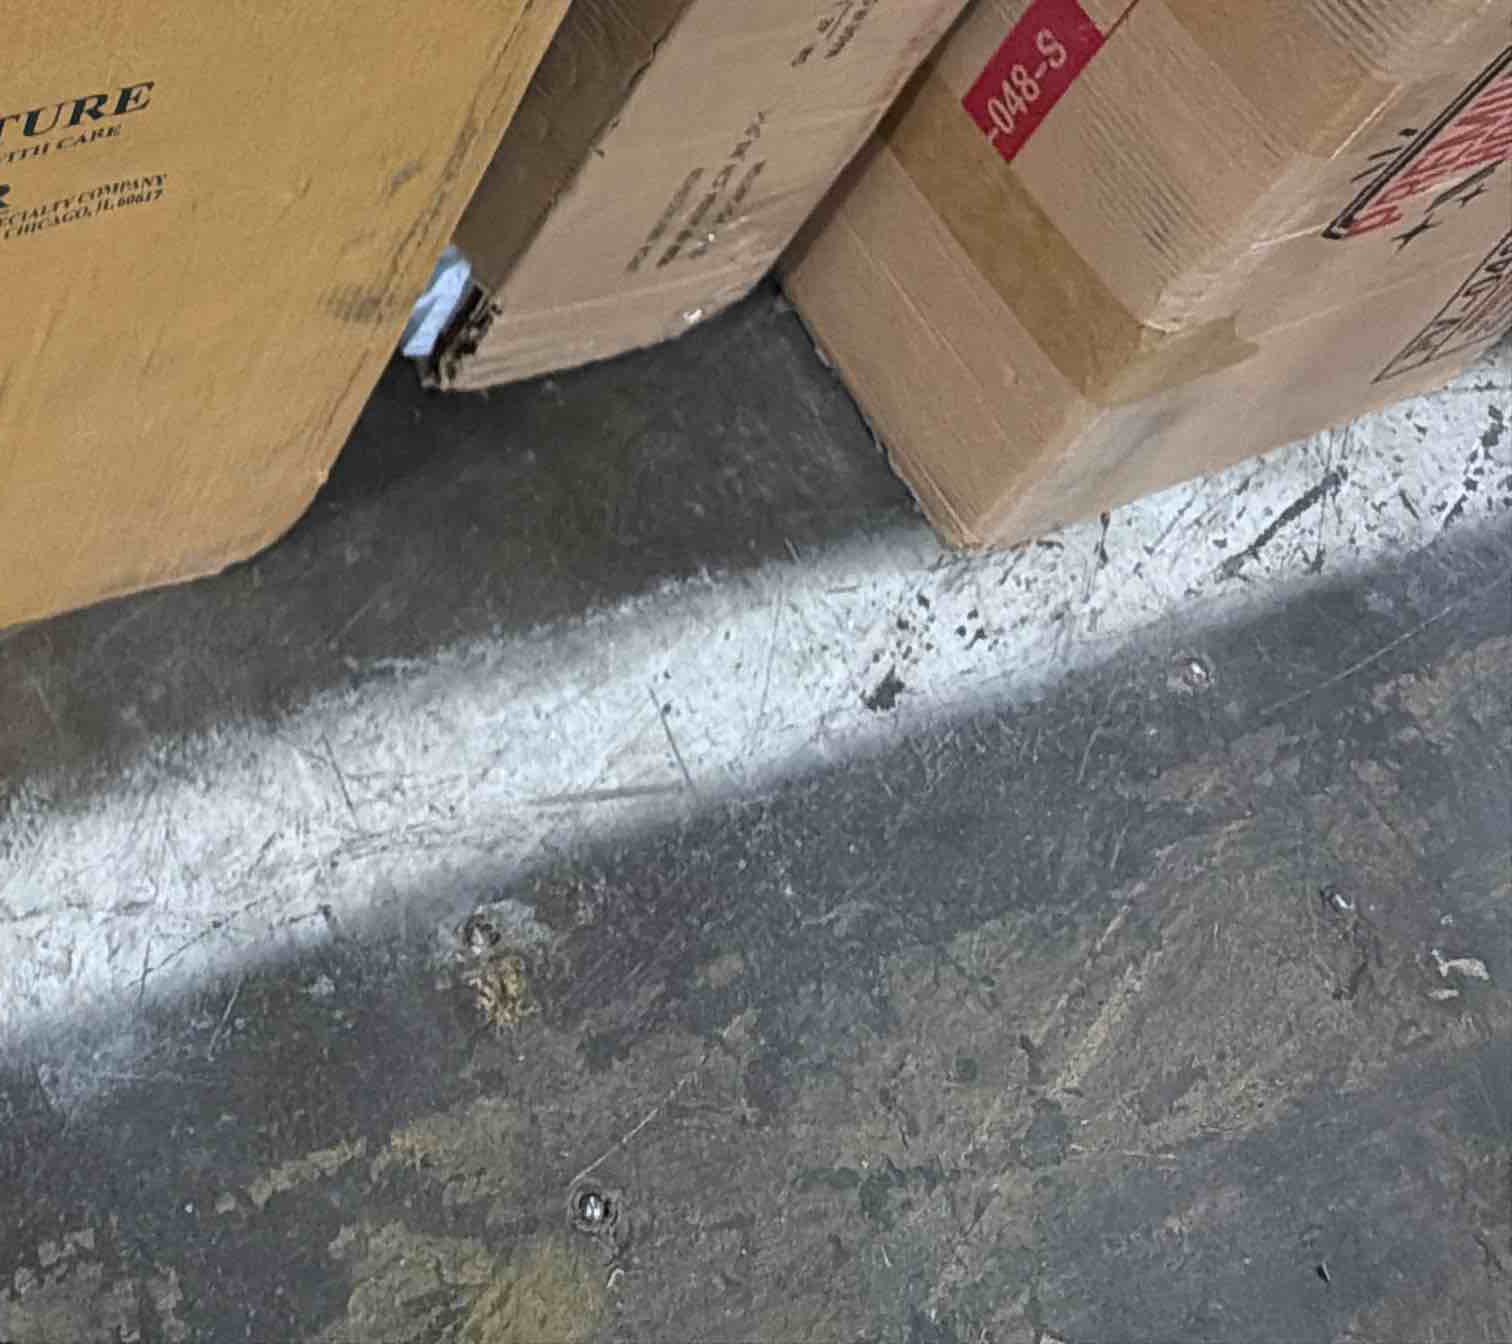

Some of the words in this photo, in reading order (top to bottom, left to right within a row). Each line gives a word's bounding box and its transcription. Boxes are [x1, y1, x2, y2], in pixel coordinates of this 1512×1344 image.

[55, 124, 124, 153] CARE
[75, 173, 169, 206] COMPANY
[116, 188, 165, 210] 60617
